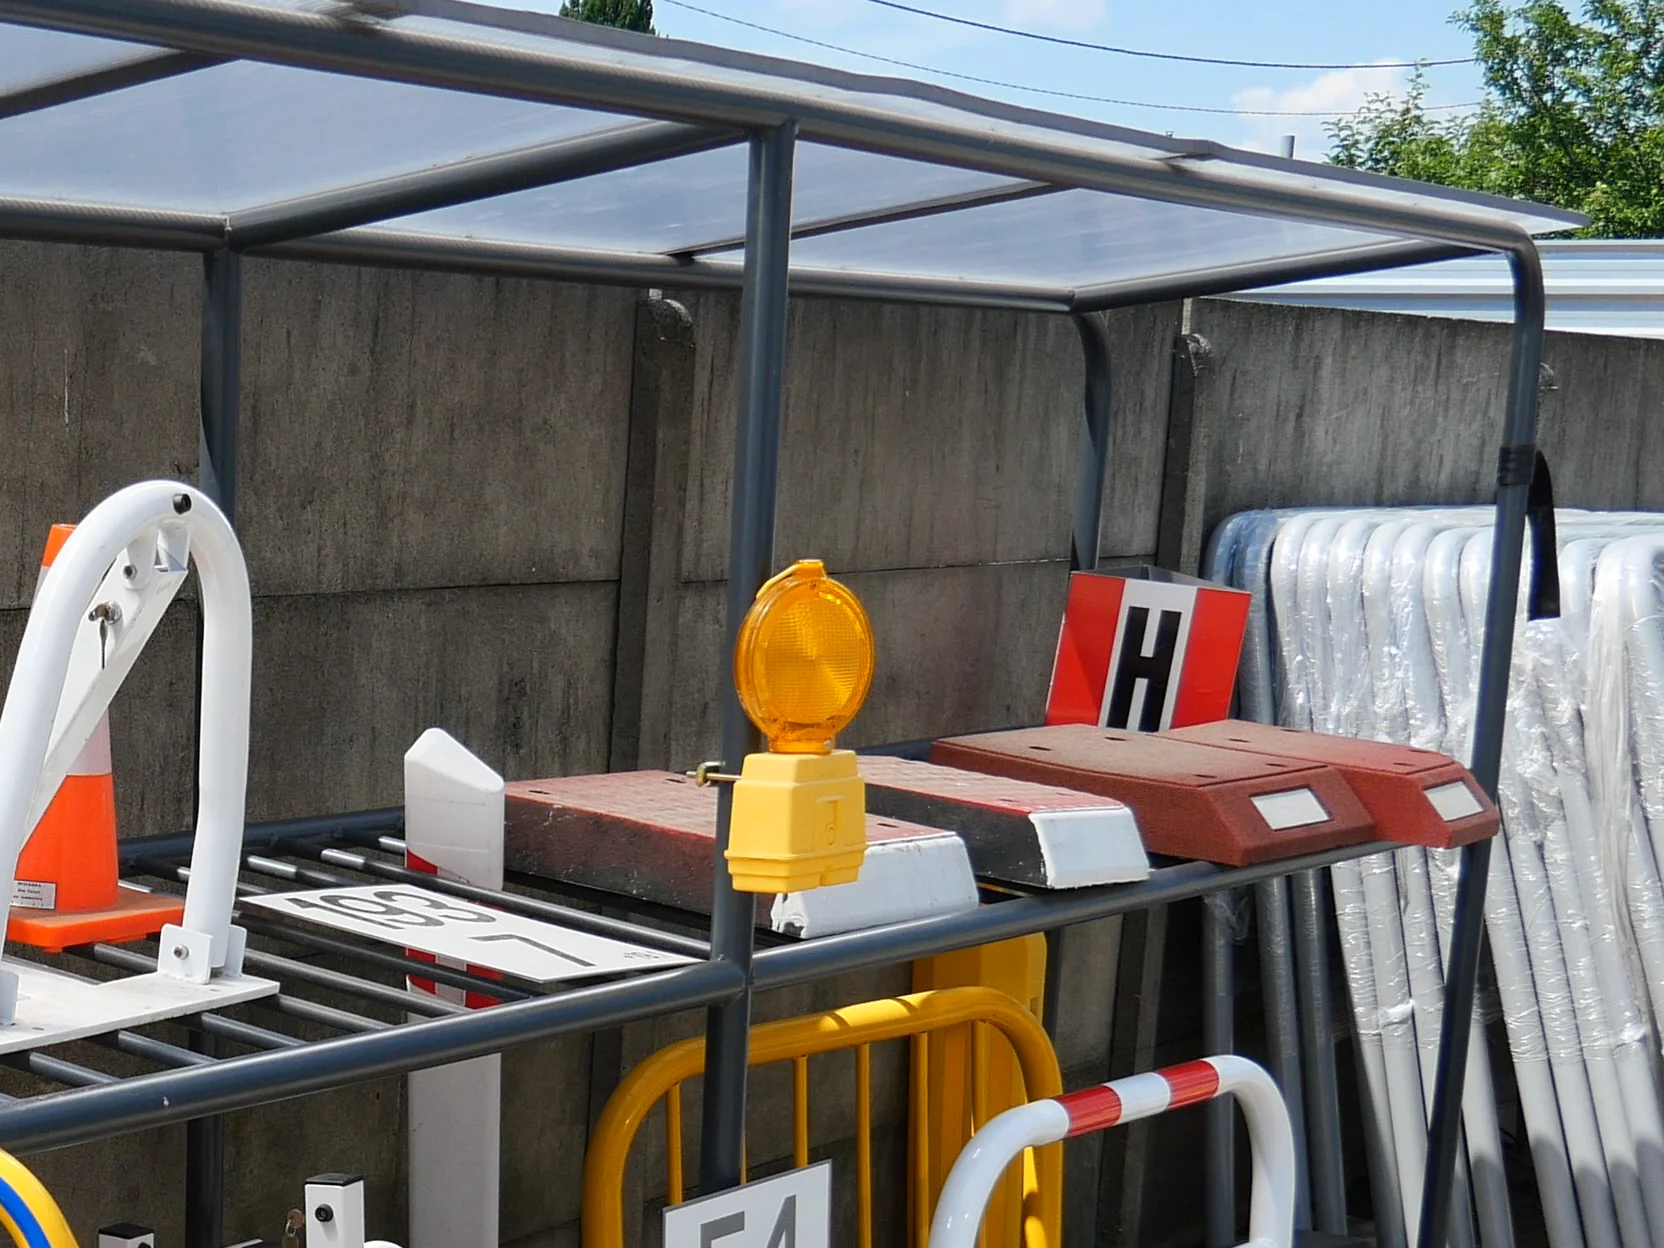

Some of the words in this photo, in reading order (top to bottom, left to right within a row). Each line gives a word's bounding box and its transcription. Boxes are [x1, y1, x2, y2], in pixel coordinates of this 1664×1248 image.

[1105, 605, 1183, 733] H
[284, 890, 497, 930] 193
[468, 933, 598, 967] 7
